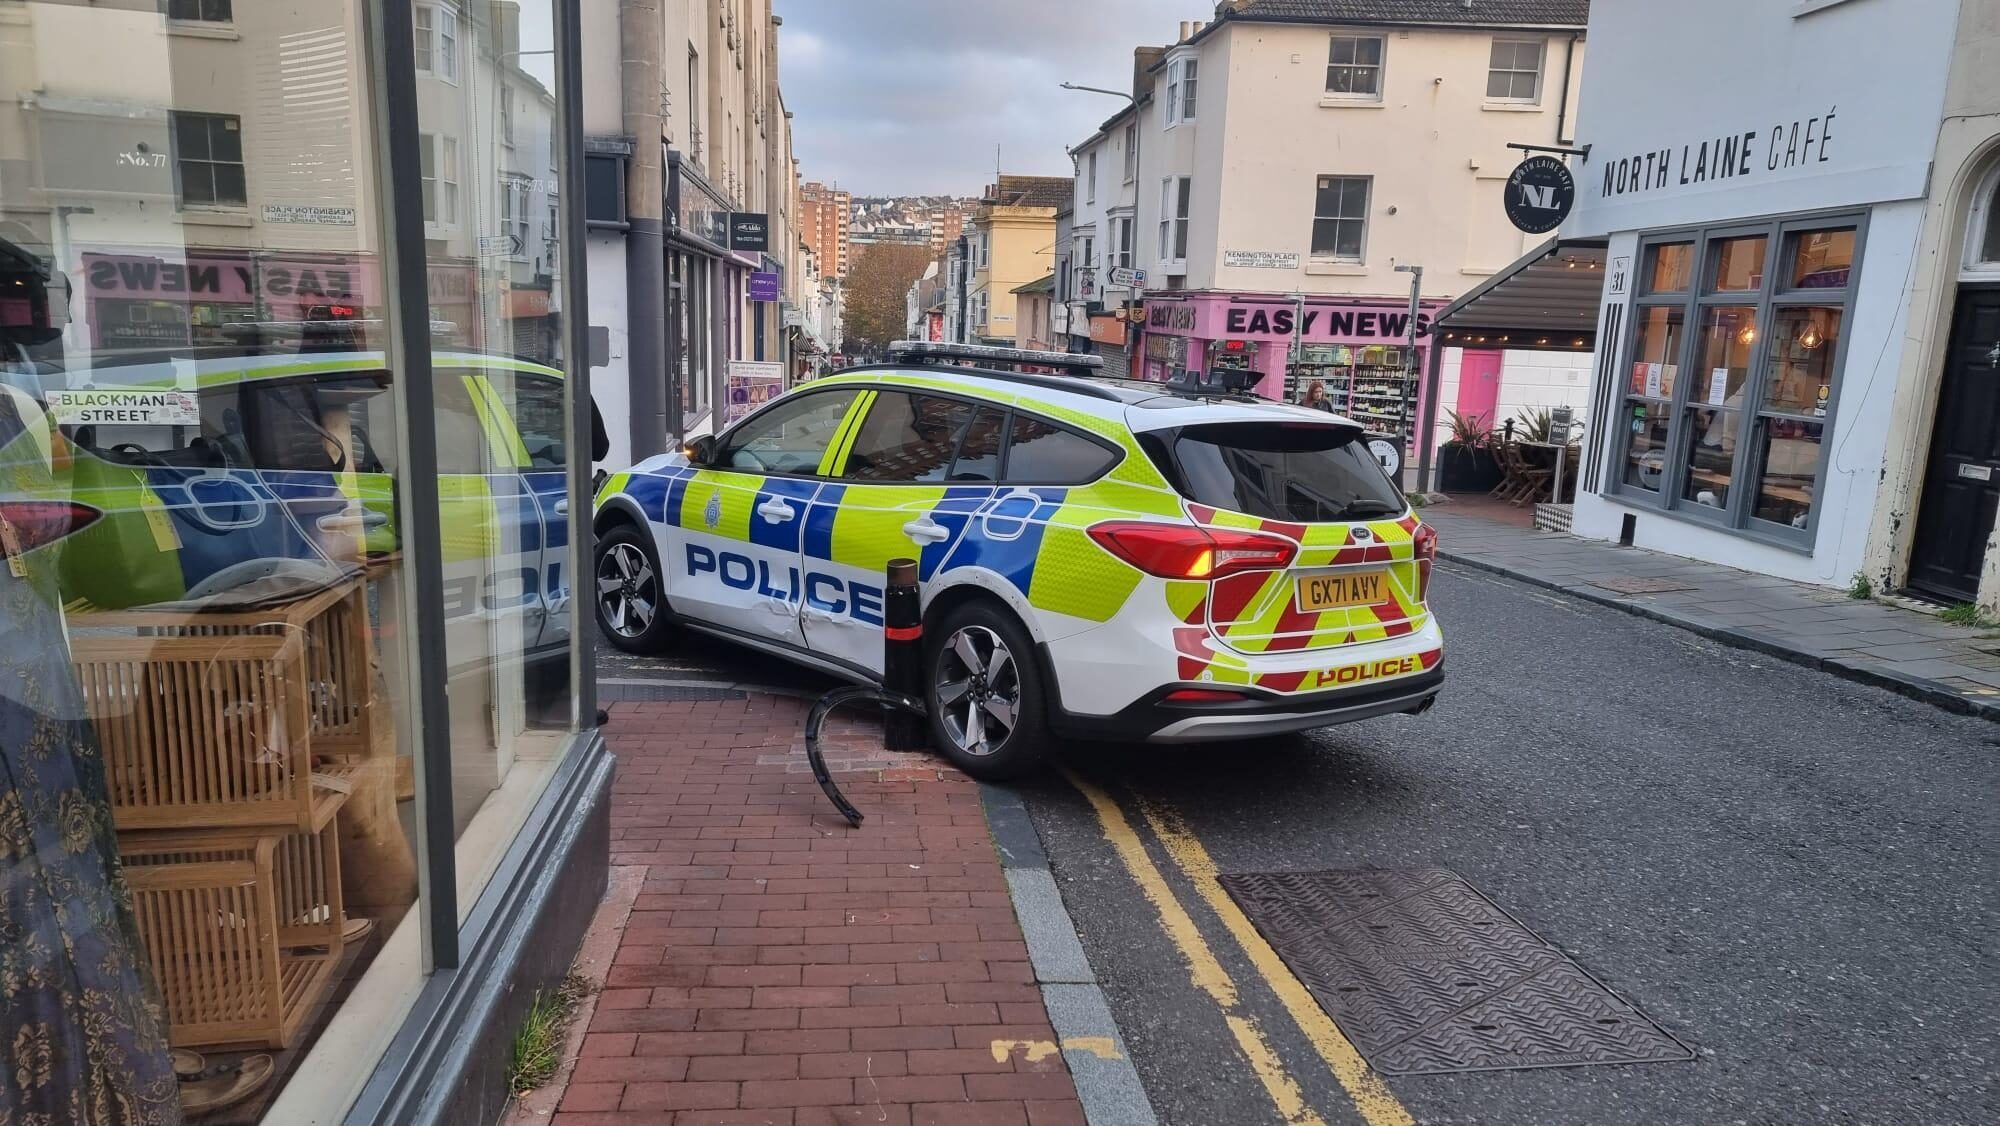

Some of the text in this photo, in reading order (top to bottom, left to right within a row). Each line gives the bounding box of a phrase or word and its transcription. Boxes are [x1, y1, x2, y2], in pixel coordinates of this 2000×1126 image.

[152, 153, 167, 168] 77
[1602, 104, 1836, 198] NORTH LAINE CAFÉ
[1511, 162, 1535, 185] NORTH
[1536, 159, 1560, 172] LAINE
[1518, 184, 1561, 210] NL
[1227, 251, 1273, 259] KENSINGTON
[1612, 271, 1625, 291] 31
[1226, 308, 1430, 338] EASY NEWS
[61, 394, 165, 407] BLACKMAN
[80, 409, 150, 422] STREET
[1552, 426, 1567, 434] WAIT
[685, 542, 884, 628] POLICE
[1310, 575, 1379, 605] GX71 AVY
[1316, 658, 1414, 688] POLICE
